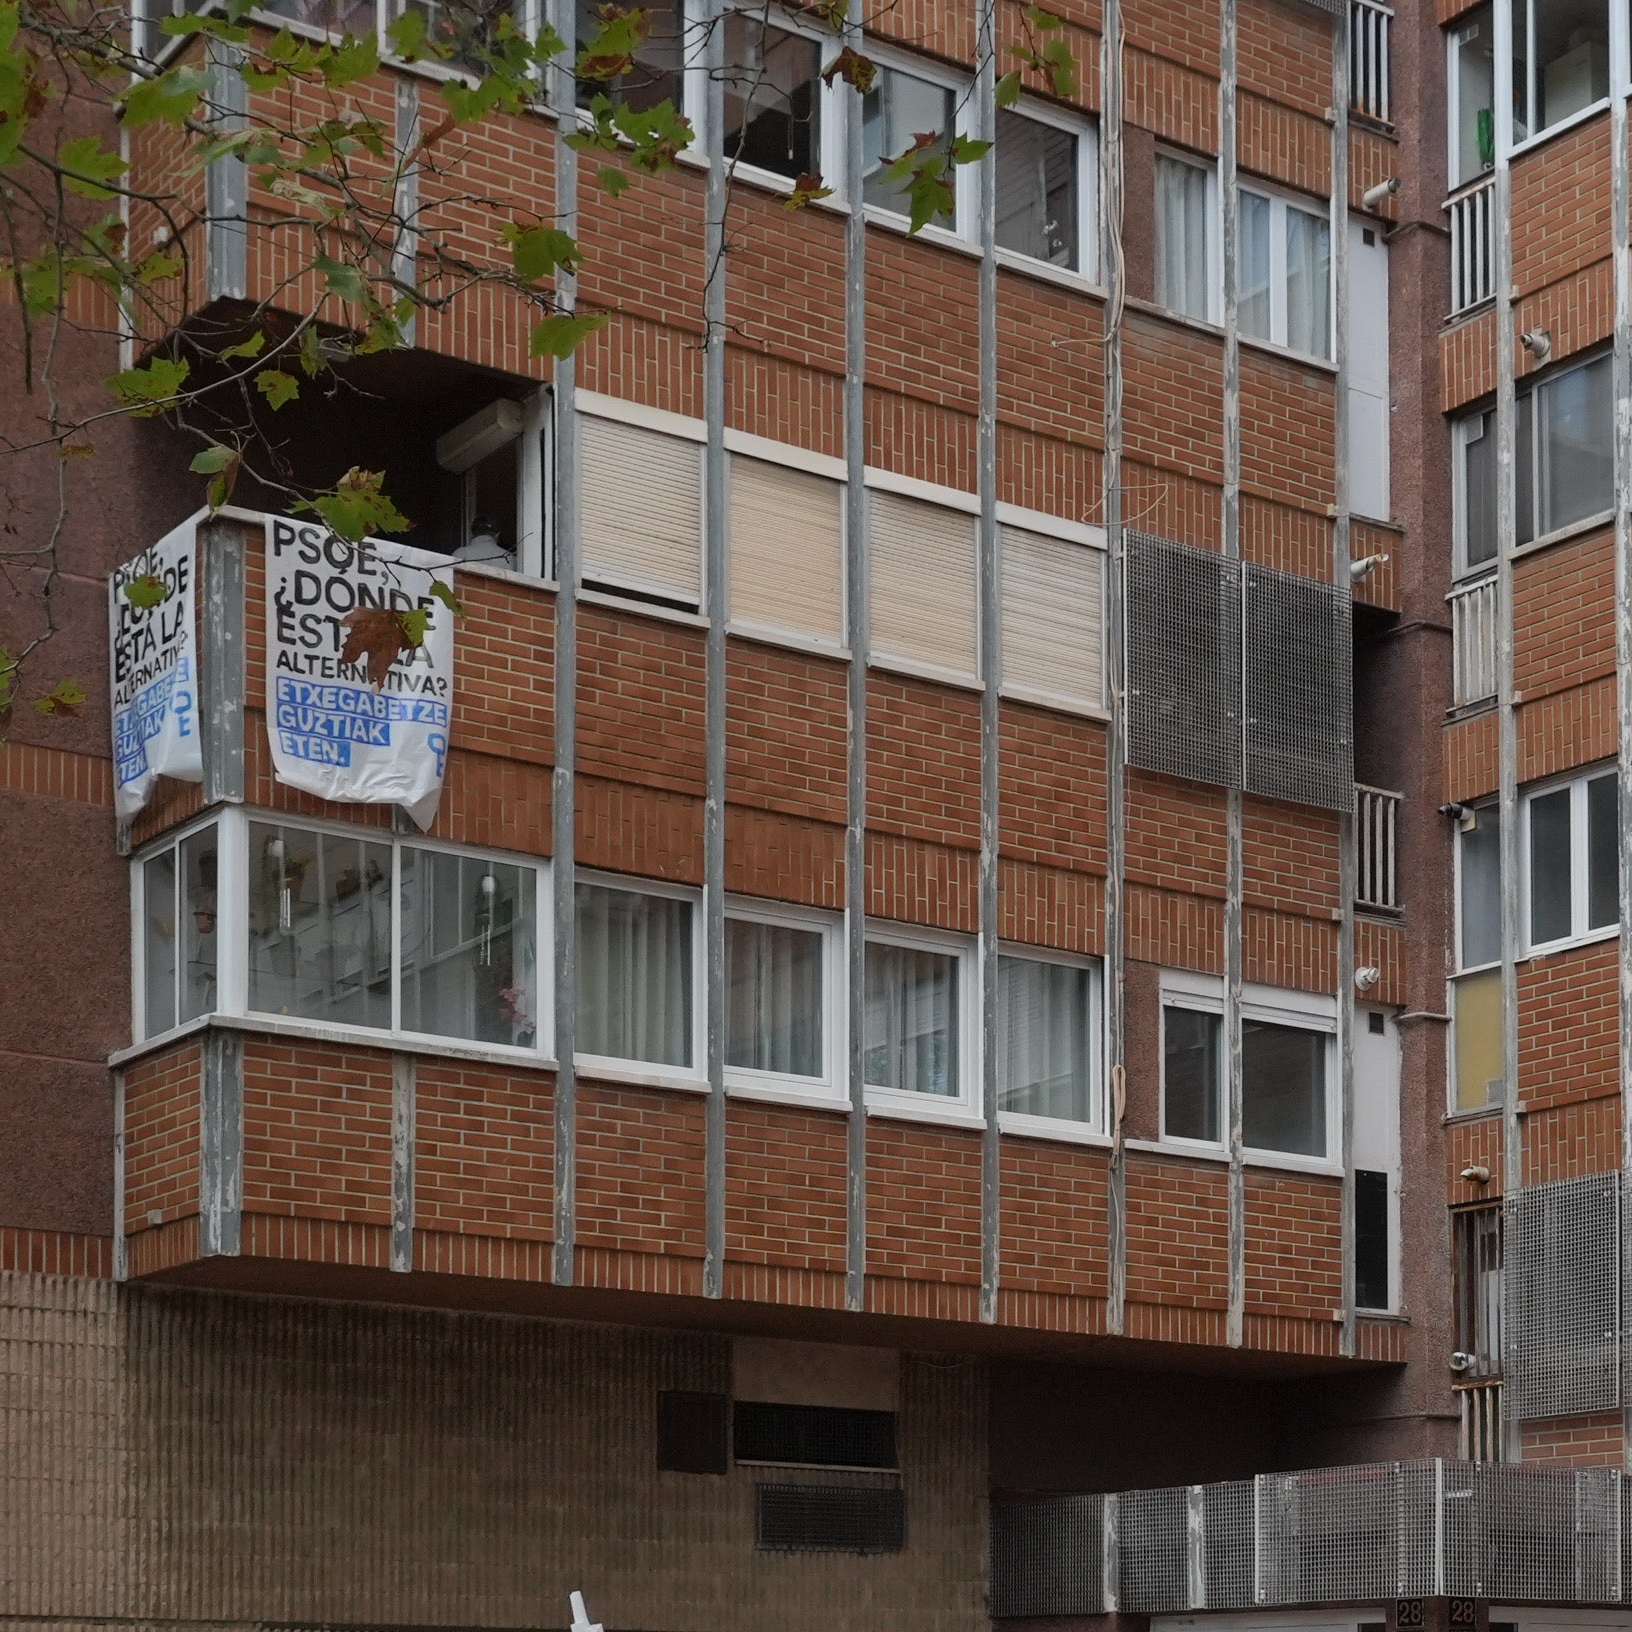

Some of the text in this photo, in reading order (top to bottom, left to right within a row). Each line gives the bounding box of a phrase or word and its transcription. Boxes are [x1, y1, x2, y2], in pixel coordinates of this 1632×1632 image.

[273, 519, 390, 586] PSOE,
[276, 649, 448, 698] ALTERNTIVA?
[277, 677, 448, 727] ETXEGABETZE
[278, 703, 389, 746] GUZTIAK
[1398, 1601, 1422, 1624] 28
[1451, 1600, 1475, 1623] 28
